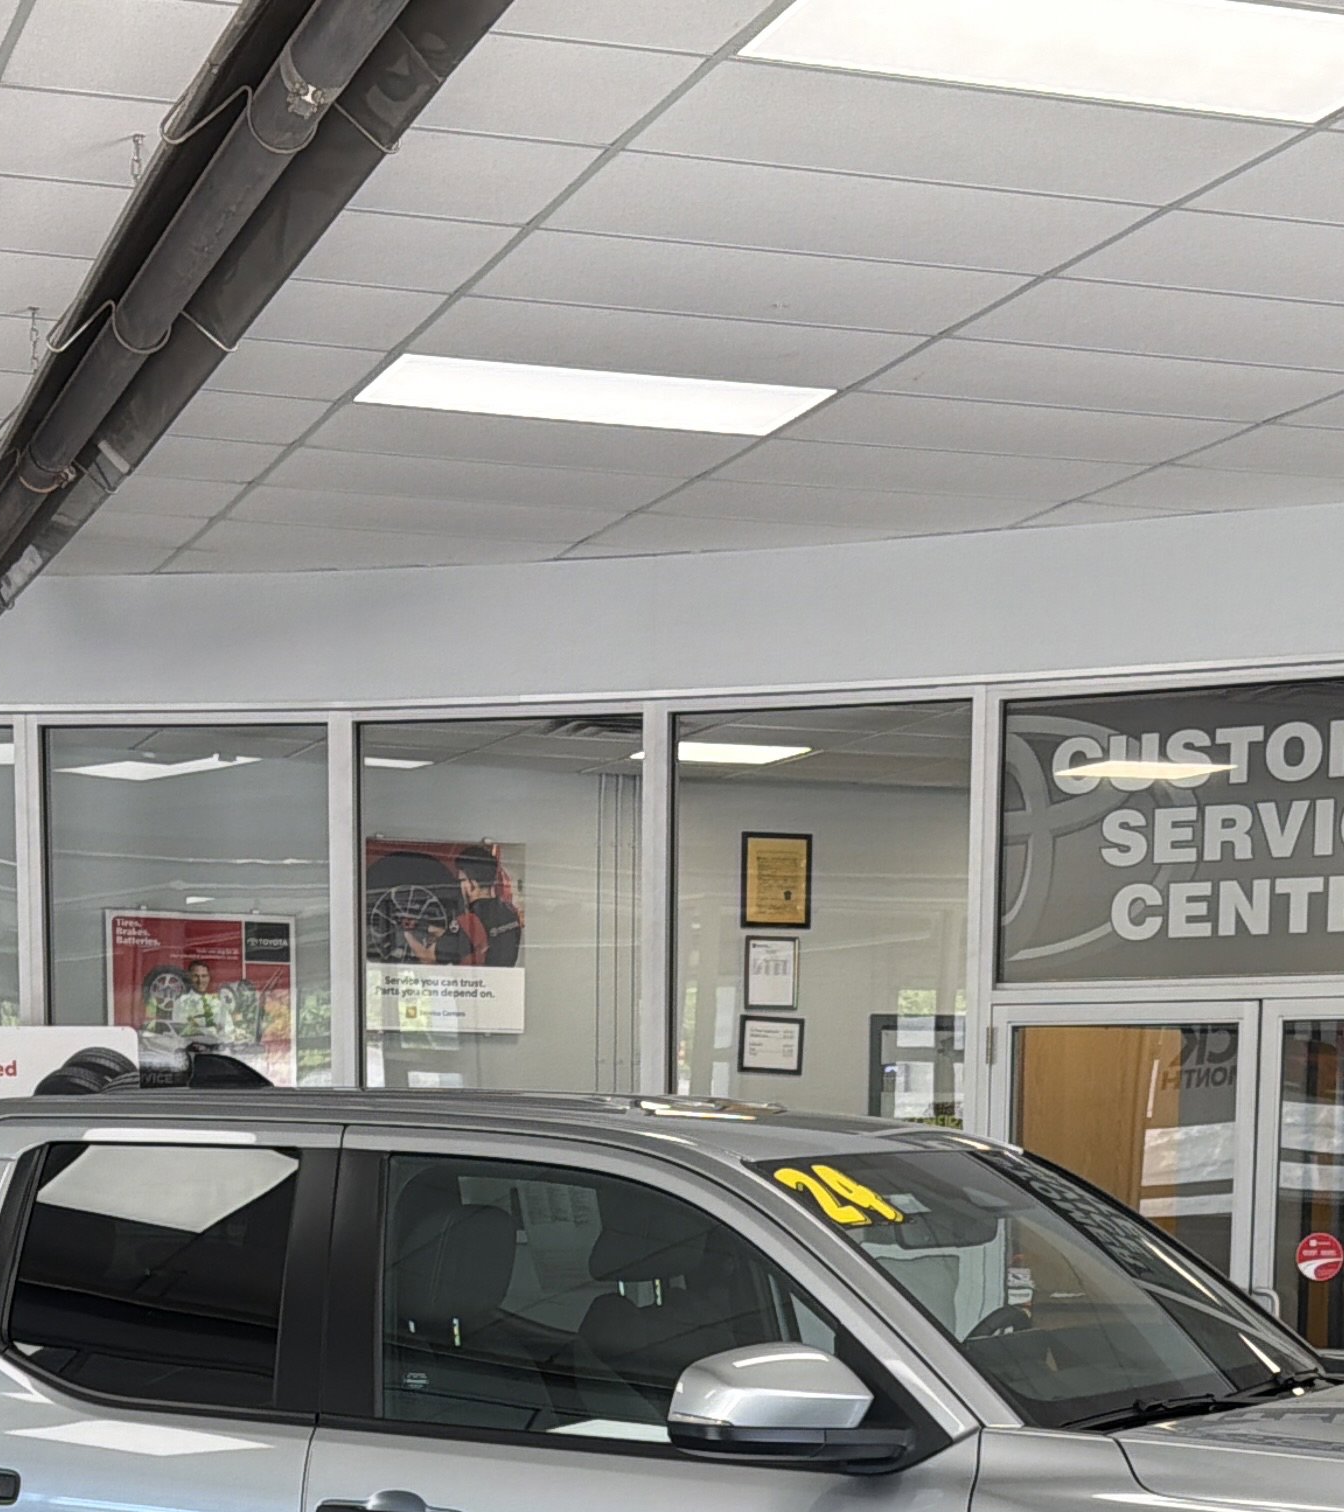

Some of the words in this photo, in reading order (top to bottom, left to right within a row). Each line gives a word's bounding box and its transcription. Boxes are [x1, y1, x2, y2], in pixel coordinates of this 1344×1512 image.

[115, 918, 143, 928] Tires.
[115, 927, 151, 937] Brakes.
[115, 936, 162, 947] Batteries.
[259, 938, 289, 947] TOYOTA
[384, 975, 420, 986] Service
[421, 978, 440, 988] you
[441, 979, 458, 987] can
[460, 977, 486, 987] trust.
[401, 987, 421, 998] you
[441, 988, 478, 1001] depend
[480, 990, 496, 999] on.
[773, 1164, 904, 1226] 24
